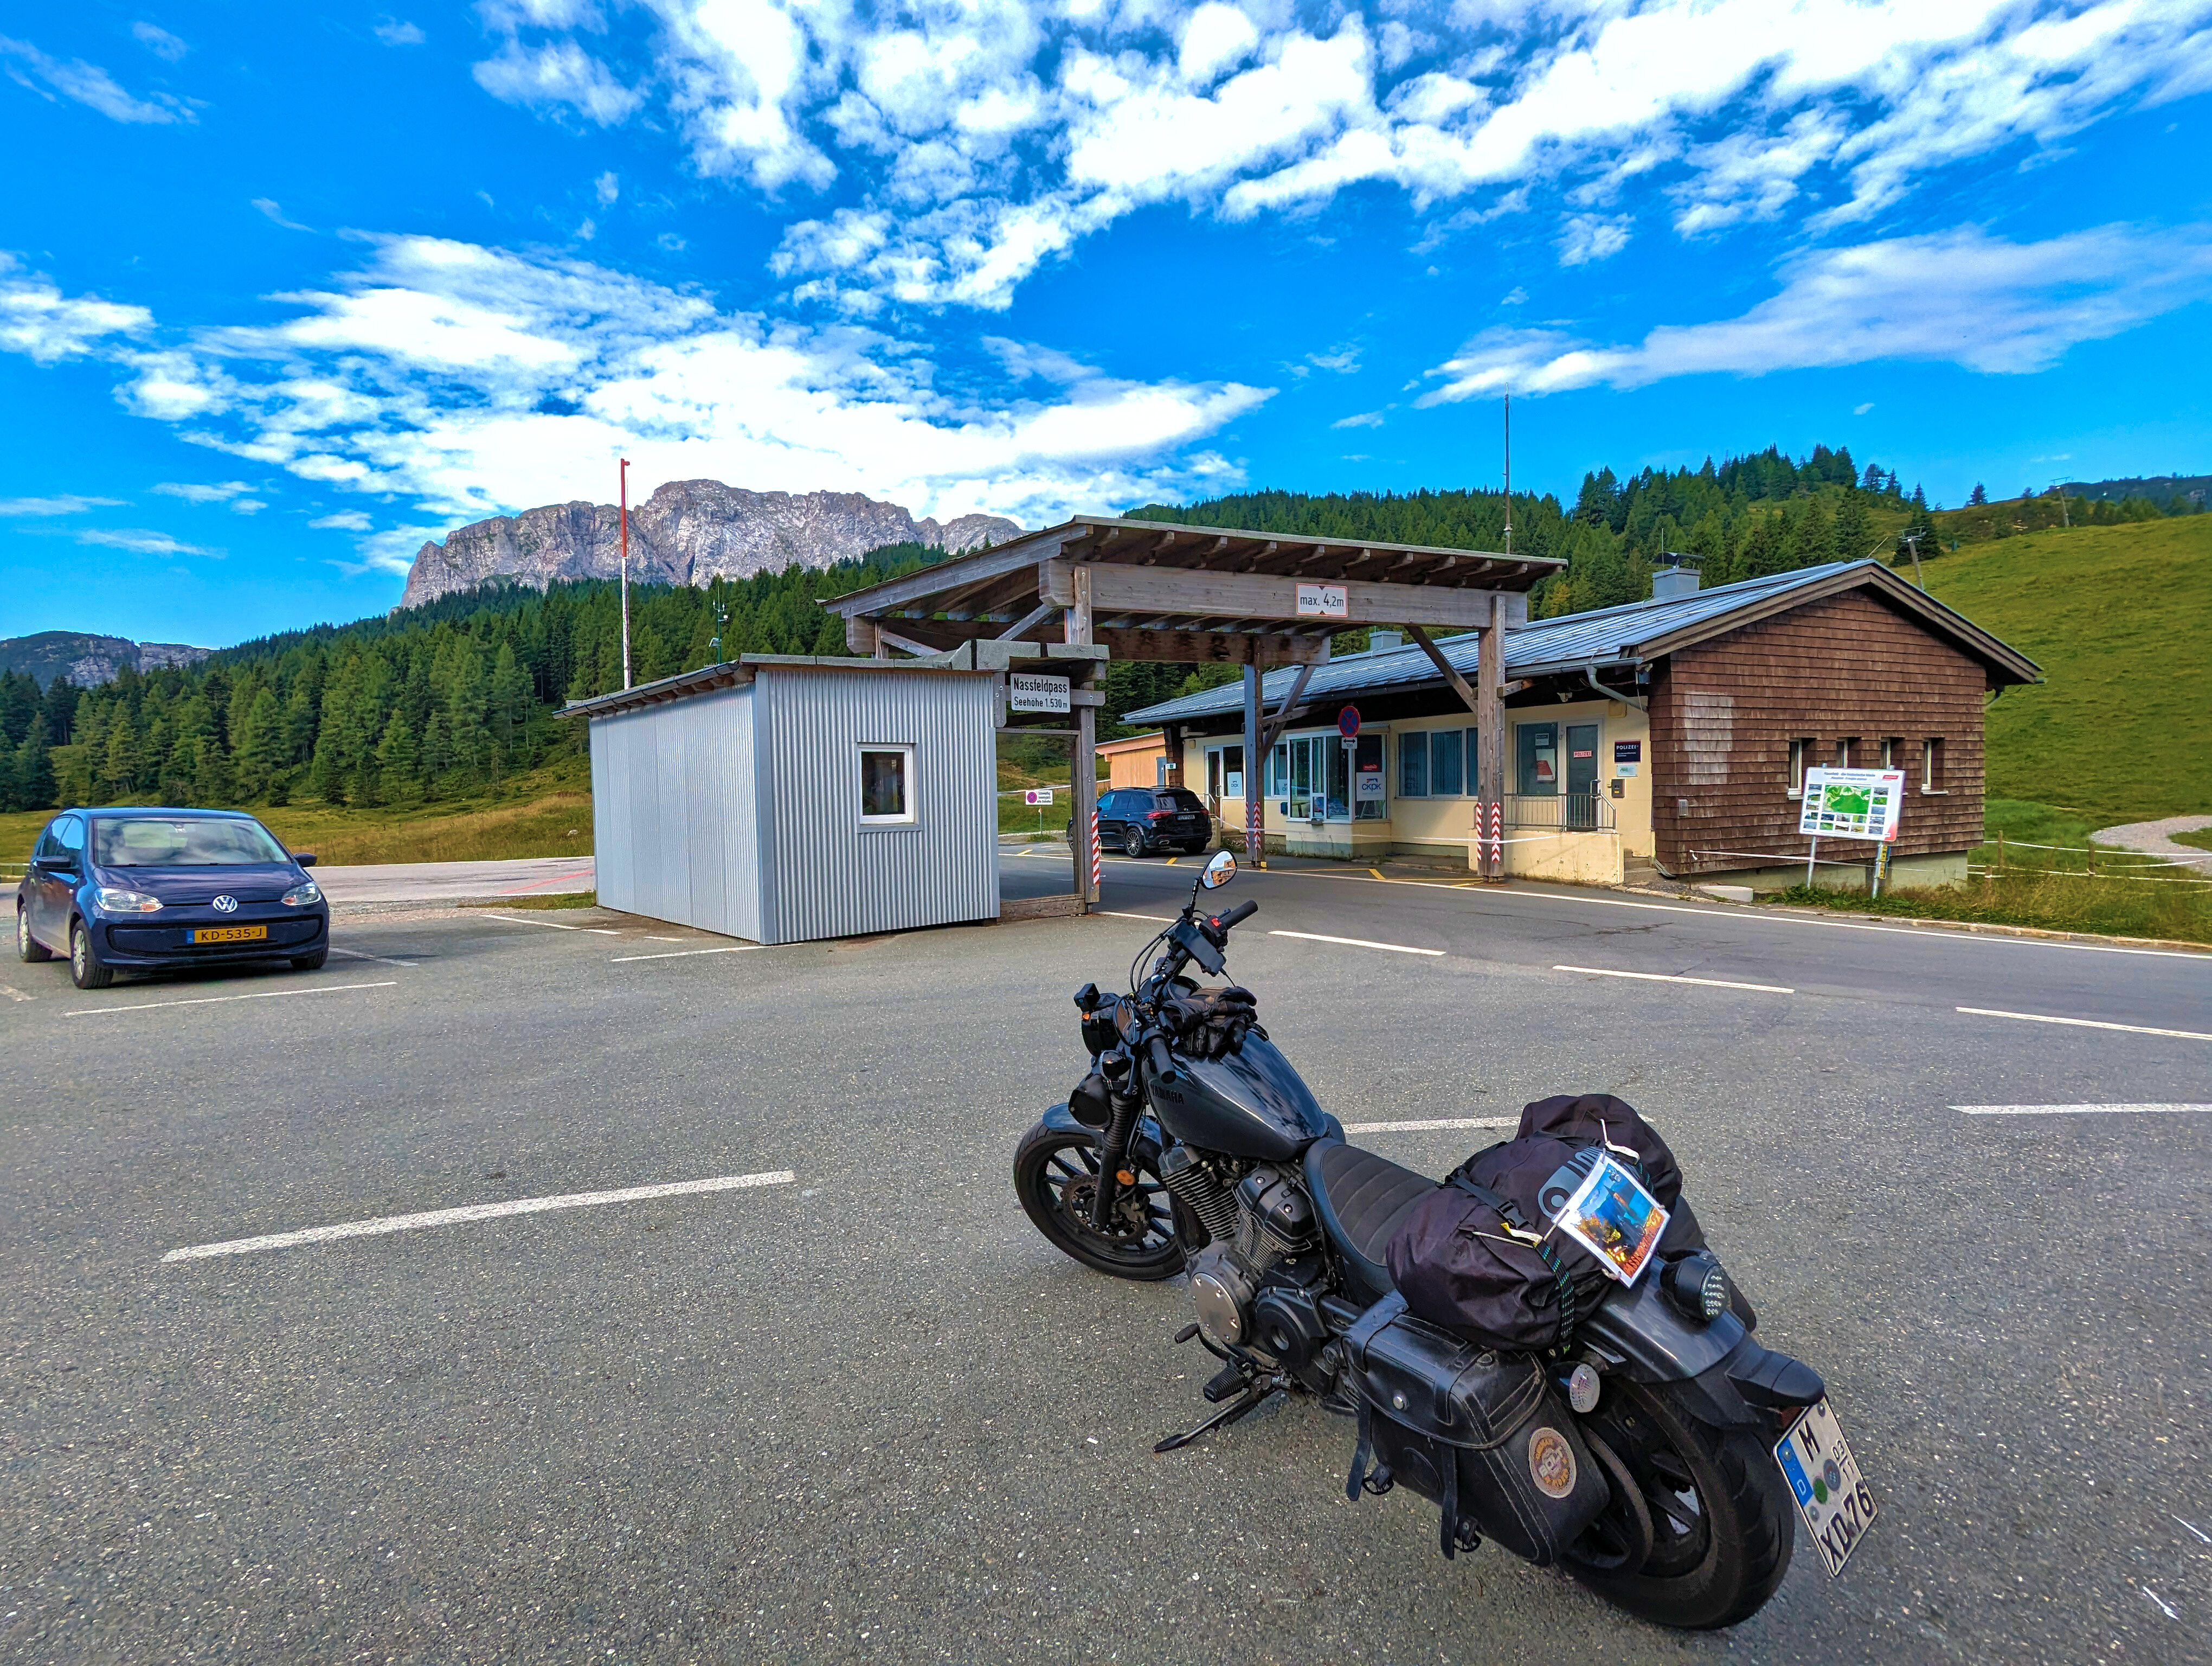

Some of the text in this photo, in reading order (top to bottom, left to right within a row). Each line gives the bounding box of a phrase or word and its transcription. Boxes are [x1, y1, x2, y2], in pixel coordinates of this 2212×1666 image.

[1300, 593, 1344, 608] max. 4,2m
[1013, 677, 1067, 696] Nassfeldpass
[1014, 696, 1043, 707] Seehöhe
[201, 927, 262, 941] KD-535-J
[1150, 1084, 1184, 1105] YAMAHA
[1797, 1420, 1821, 1463] M
[1796, 1479, 1806, 1496] D
